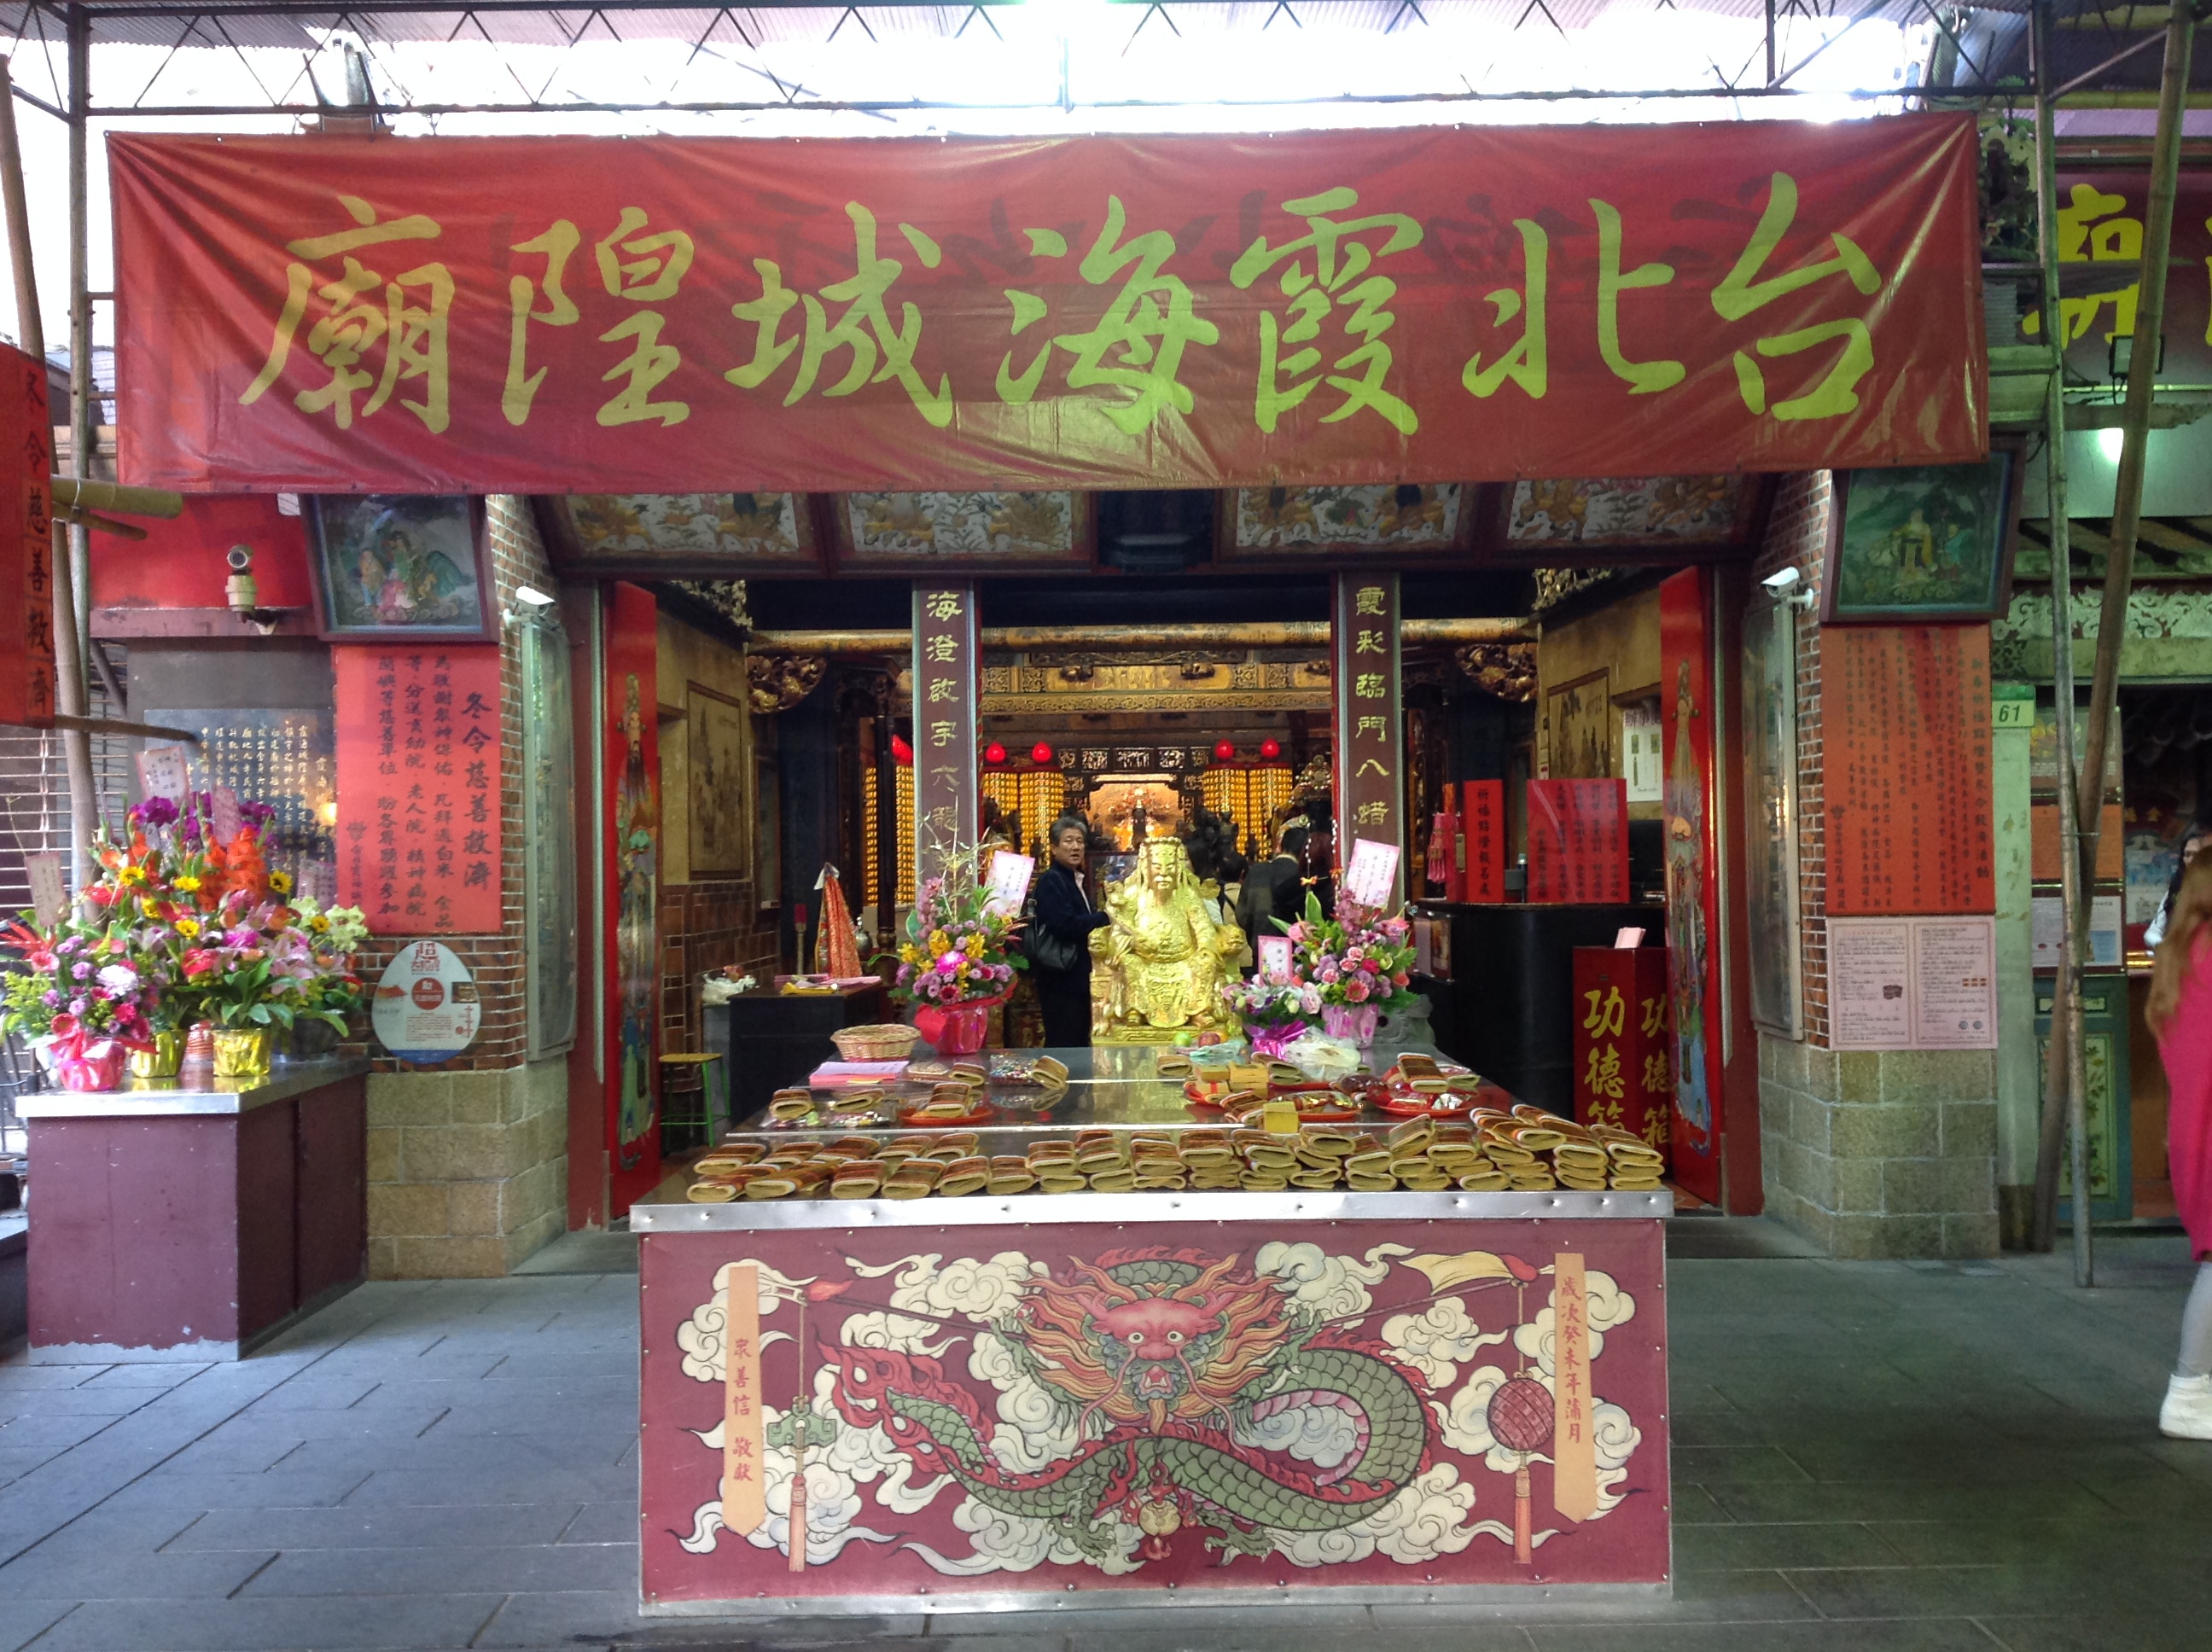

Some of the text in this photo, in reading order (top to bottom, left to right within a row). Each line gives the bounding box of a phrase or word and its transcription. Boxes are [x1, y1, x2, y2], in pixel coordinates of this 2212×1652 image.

[1999, 704, 2021, 723] 61
[461, 692, 492, 890] 冬令慈善救濟
